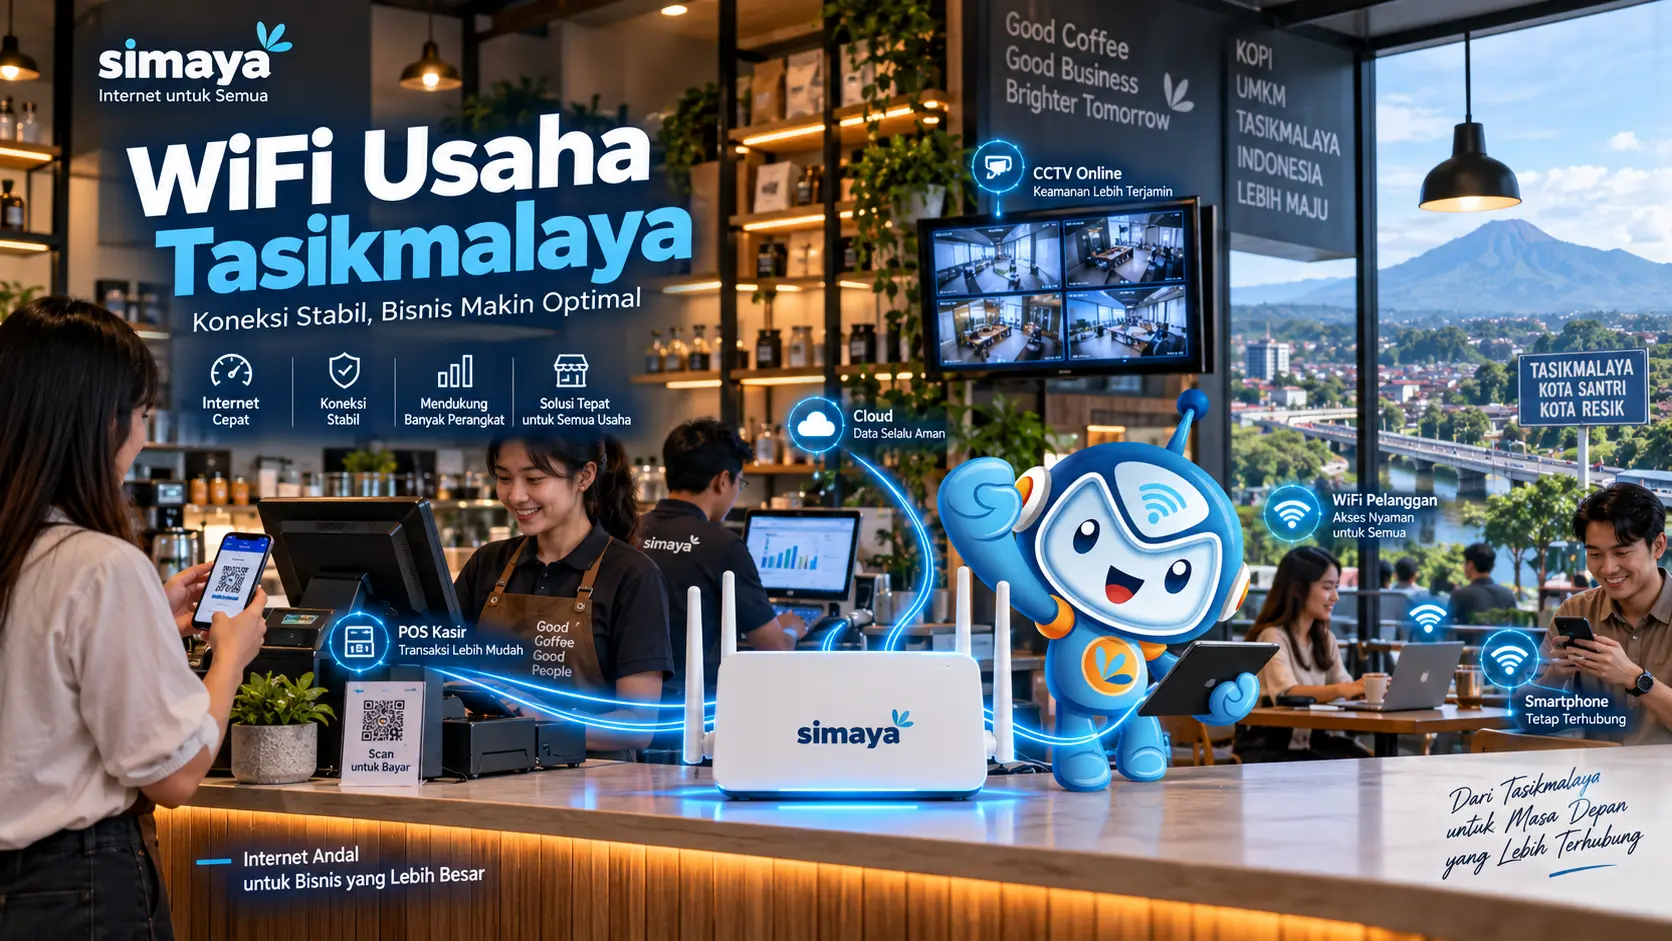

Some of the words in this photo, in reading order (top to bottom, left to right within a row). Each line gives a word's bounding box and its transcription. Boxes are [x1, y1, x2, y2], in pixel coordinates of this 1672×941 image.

[1006, 11, 1055, 44] Good
[1062, 23, 1129, 60] Coffee
[1006, 46, 1054, 78] Good
[1062, 57, 1139, 94] Business
[1236, 39, 1273, 70] KOPI
[1006, 78, 1077, 115] Brighter
[1082, 94, 1170, 131] Tomorrow
[1236, 76, 1286, 108] UMKM
[1236, 110, 1341, 156] TASIKMALAYA
[1237, 145, 1323, 186] INDONESIA
[1237, 182, 1282, 211] LEBIH
[1286, 191, 1328, 221] MAJU
[1530, 359, 1634, 378] TASIKMALAYA
[1539, 381, 1574, 397] KOTA
[1578, 380, 1626, 396] SANTRI
[1540, 402, 1576, 417] KOTA
[1582, 400, 1624, 416] RESIK
[643, 537, 692, 554] simaya
[537, 621, 569, 633] Good
[533, 650, 565, 662] Good
[532, 665, 572, 679] People
[797, 720, 900, 749] simaya
[351, 762, 379, 771] untuk
[382, 762, 410, 774] Bayar
[369, 749, 394, 759] Scan
[1449, 787, 1493, 814] Dari
[1501, 767, 1601, 805] Tasikmalaya
[1446, 811, 1495, 839] untuk
[1505, 805, 1559, 834] Masa
[1569, 798, 1628, 826] Depan
[1442, 851, 1490, 880] yang
[1497, 834, 1547, 866] Lebih
[1555, 825, 1644, 859] Terhubung
